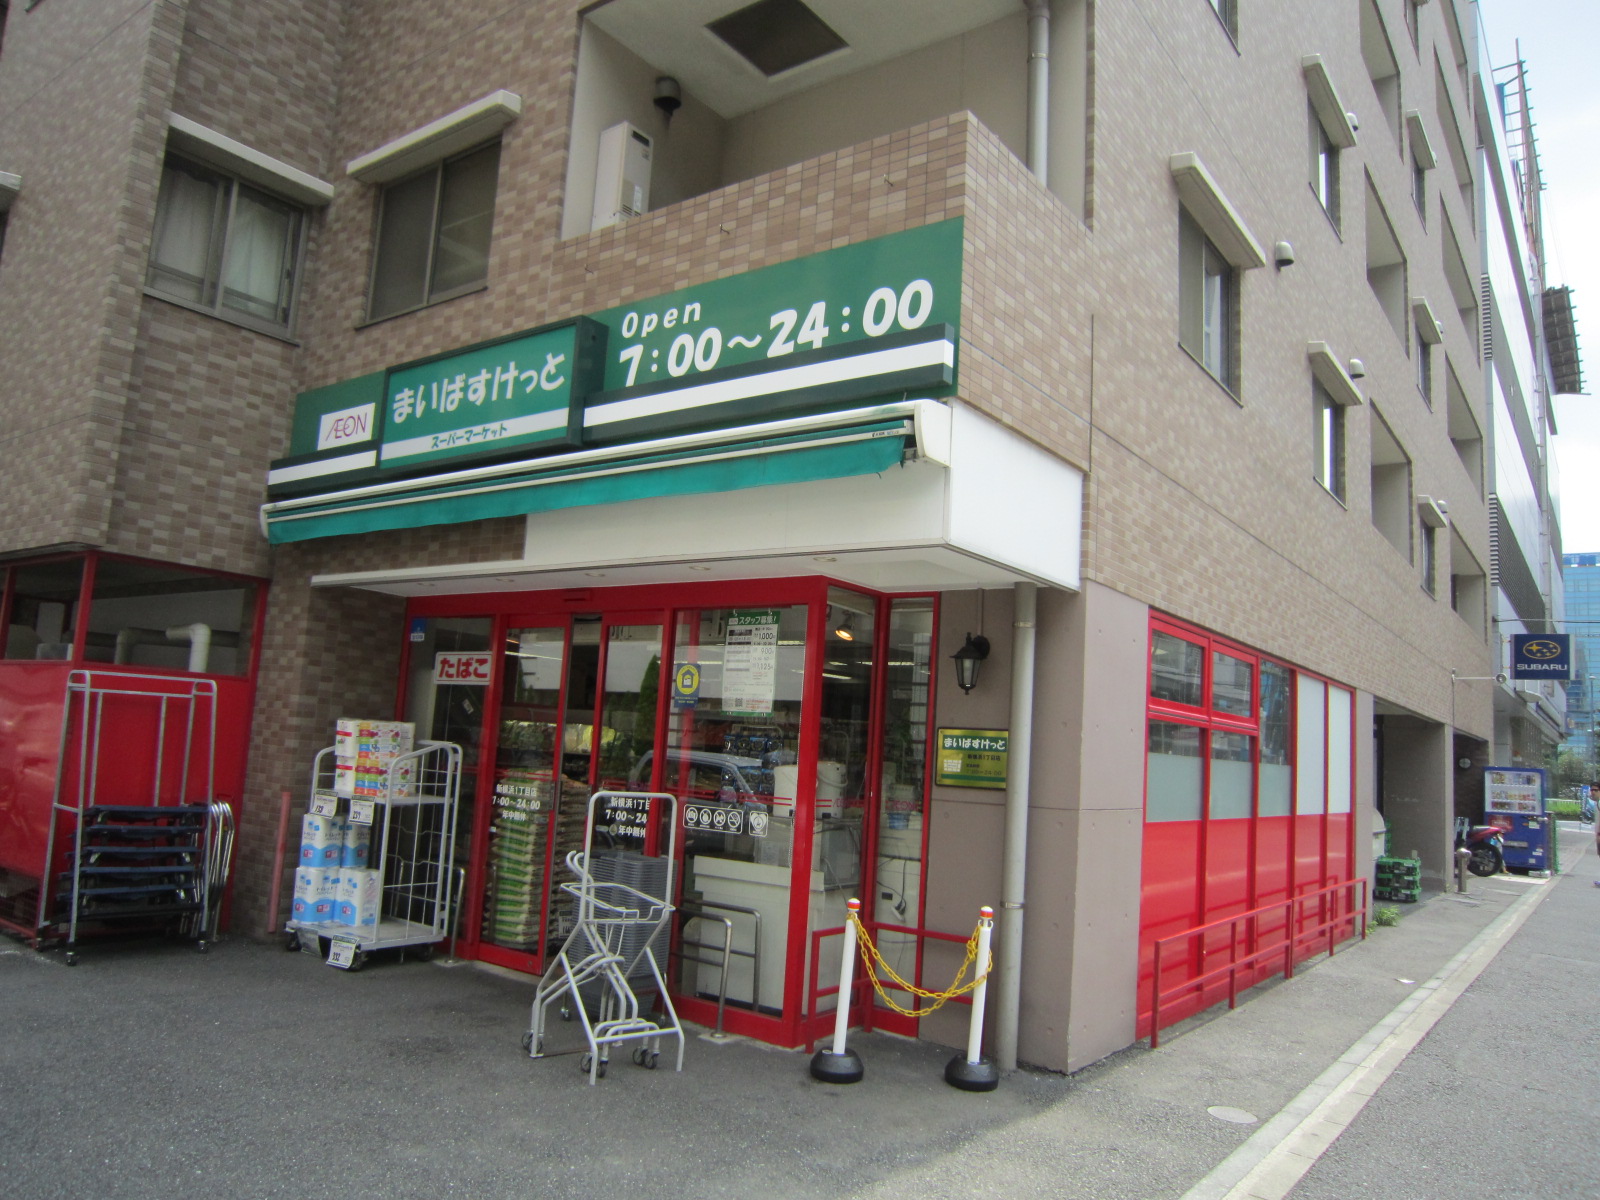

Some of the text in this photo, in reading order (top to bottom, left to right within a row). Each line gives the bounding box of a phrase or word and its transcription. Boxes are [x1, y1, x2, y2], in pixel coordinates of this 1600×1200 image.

[622, 302, 701, 338] Open
[393, 352, 565, 424] まいばすけっと
[431, 423, 507, 449] スーパーマーケット
[438, 657, 488, 679] たばこ
[1516, 663, 1568, 671] SUBARU
[944, 737, 1006, 750] まいばすけっと
